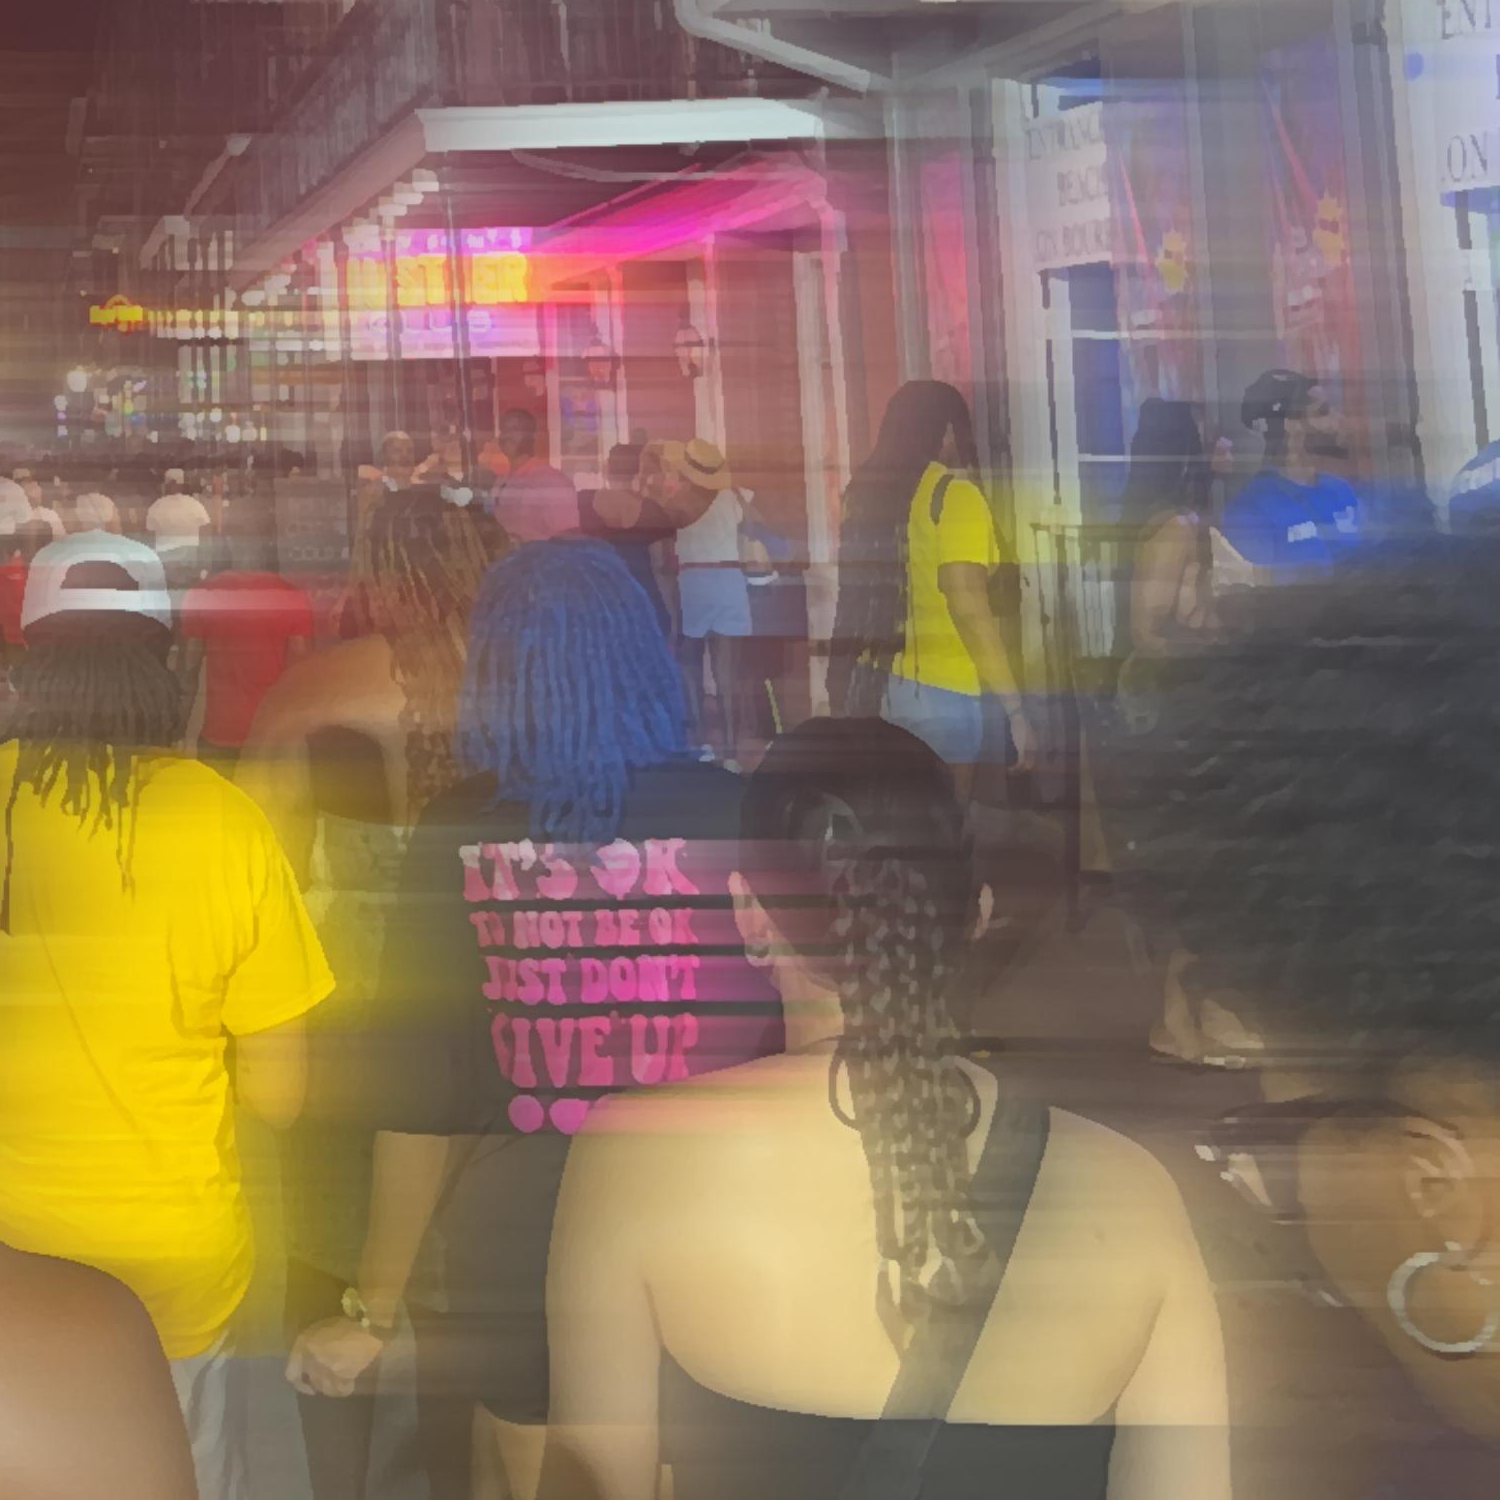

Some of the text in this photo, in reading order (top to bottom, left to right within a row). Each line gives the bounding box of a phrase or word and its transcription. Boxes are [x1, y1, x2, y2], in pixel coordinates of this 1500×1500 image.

[459, 838, 700, 902] IT'S OK
[513, 910, 583, 949] NOT
[594, 909, 641, 947] BE
[648, 907, 699, 947] OK
[580, 954, 700, 1004] DON'T
[630, 1012, 699, 1085] UP
